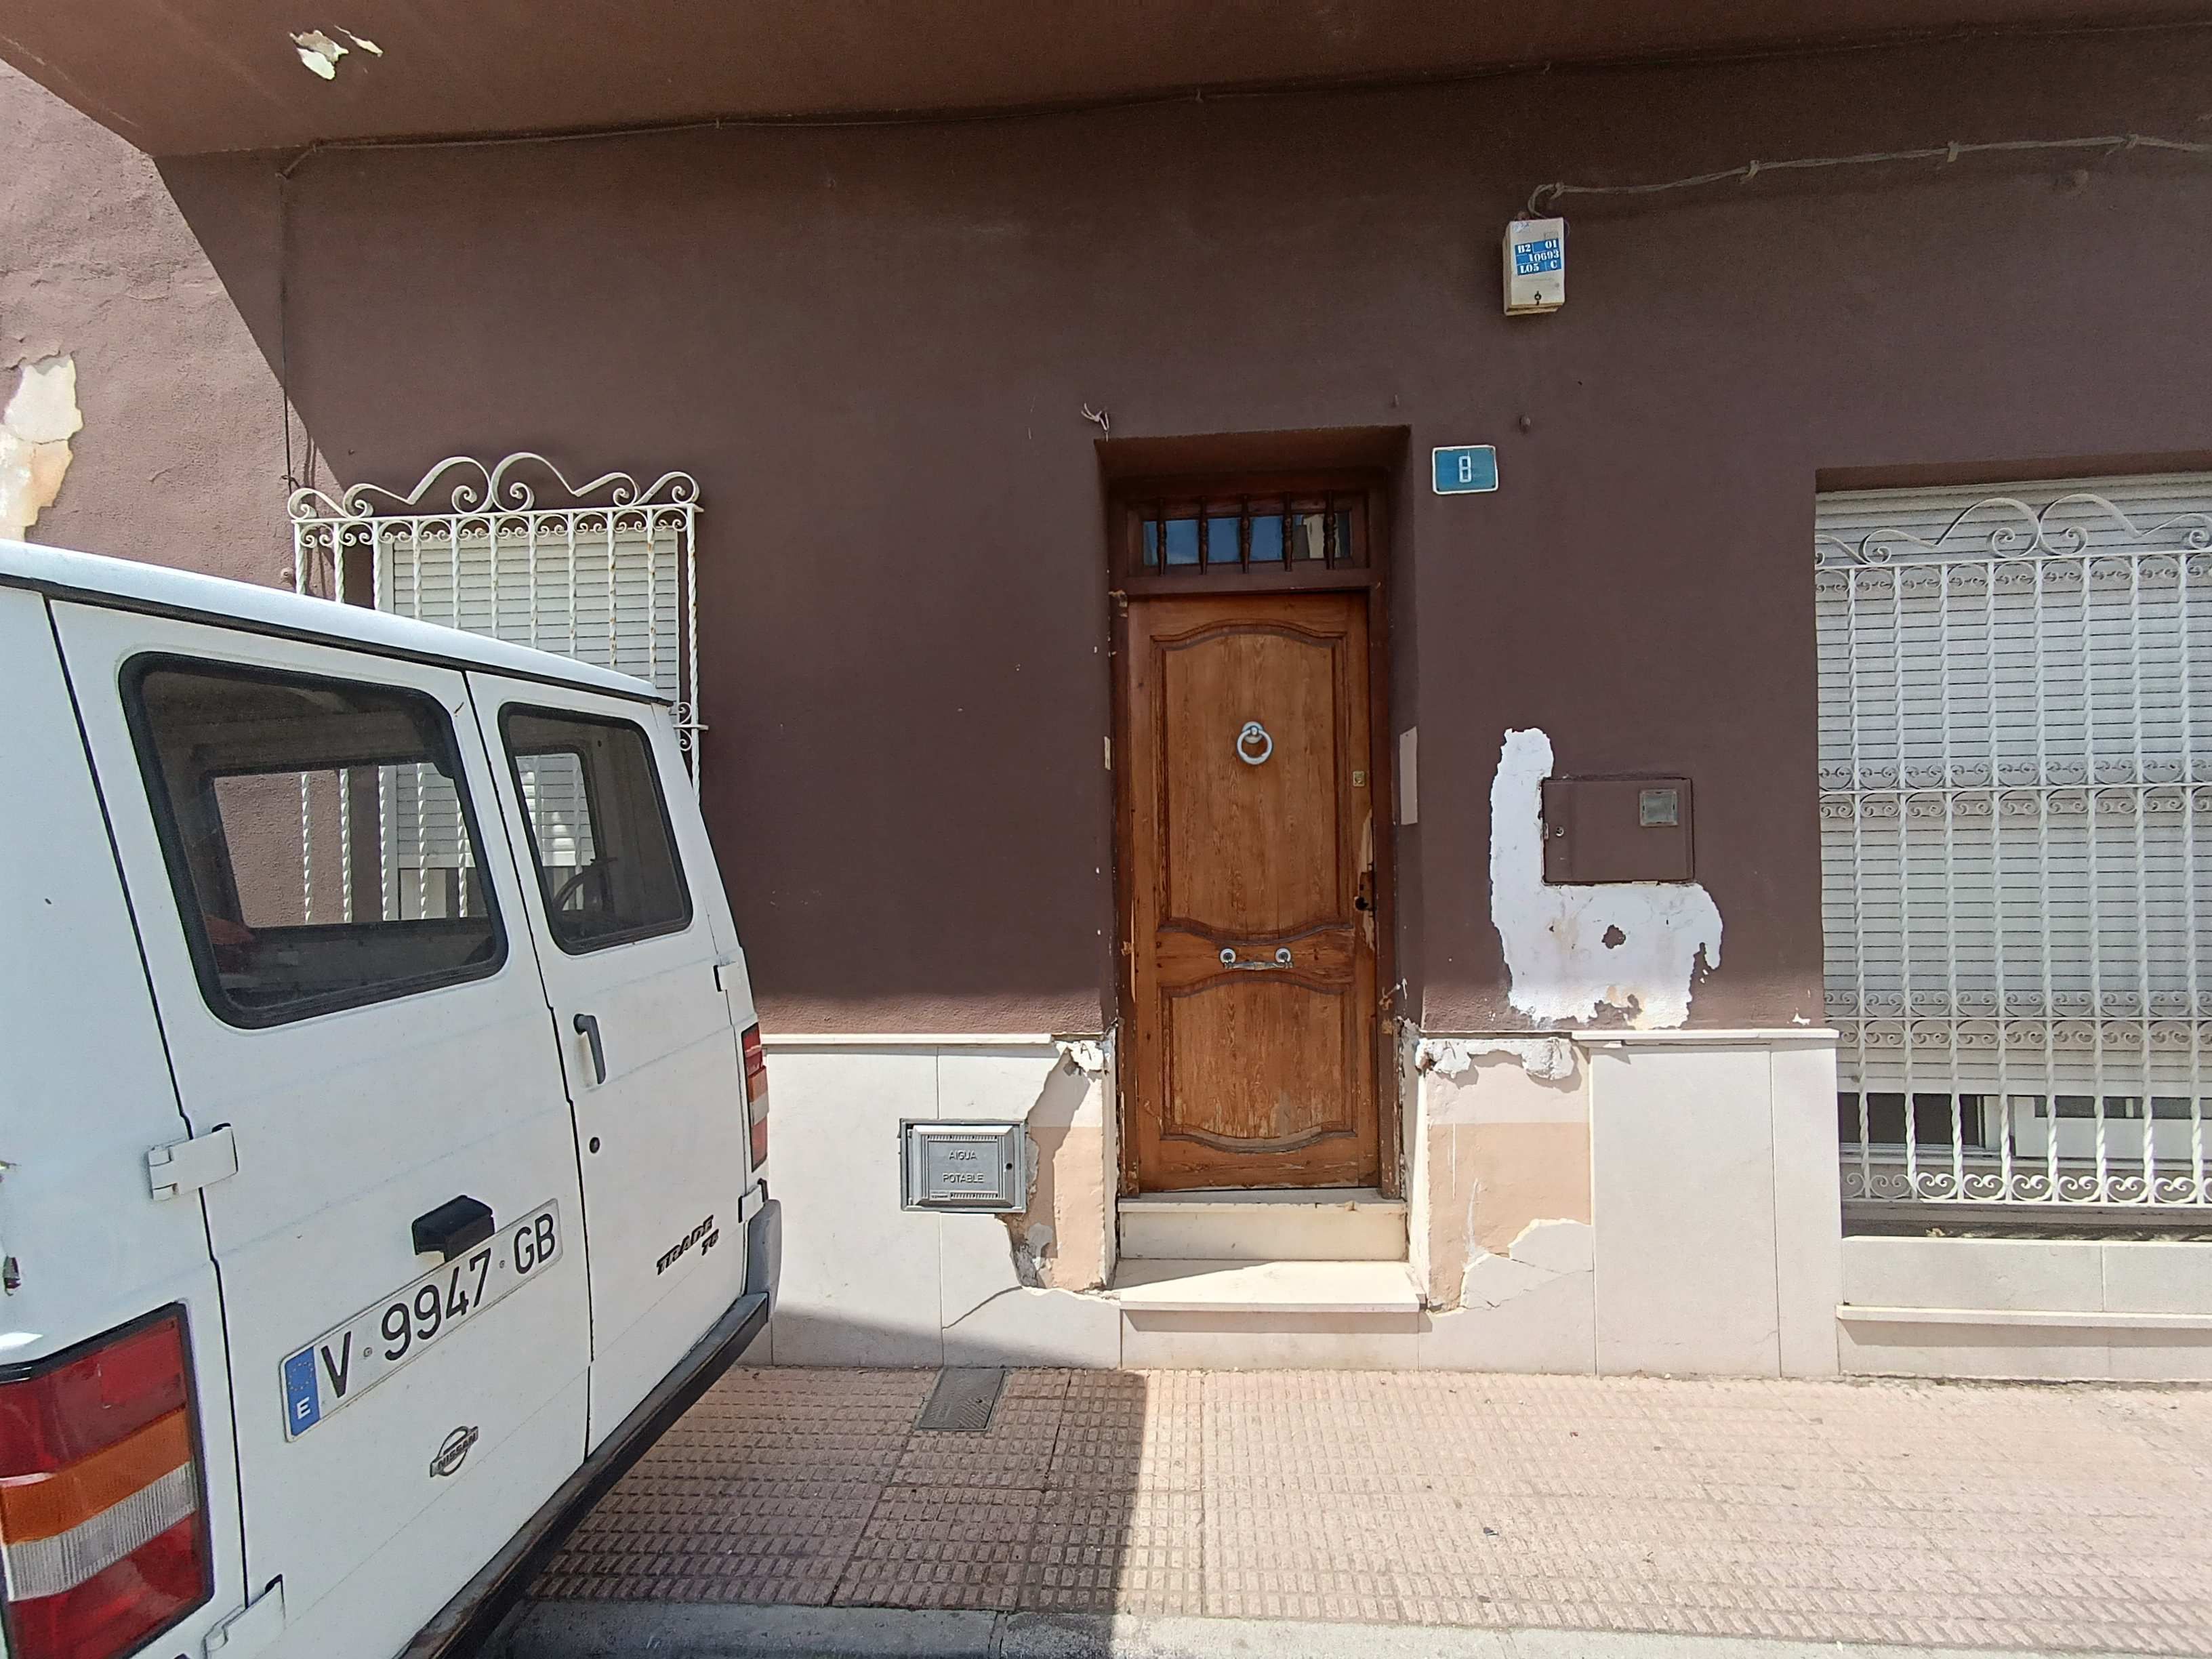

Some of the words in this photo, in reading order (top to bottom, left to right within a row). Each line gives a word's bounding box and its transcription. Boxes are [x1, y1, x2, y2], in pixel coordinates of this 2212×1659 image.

[1517, 244, 1532, 253] B2
[1550, 260, 1558, 269] C
[1458, 455, 1472, 483] 8
[949, 1150, 977, 1161] AIGUA
[943, 1172, 985, 1184] POTABLE
[656, 1214, 714, 1275] TRADE
[321, 1330, 352, 1399] V
[381, 1247, 492, 1361] 9947
[513, 1213, 556, 1275] GB
[296, 1397, 311, 1420] E
[437, 1430, 477, 1471] NISSAN
